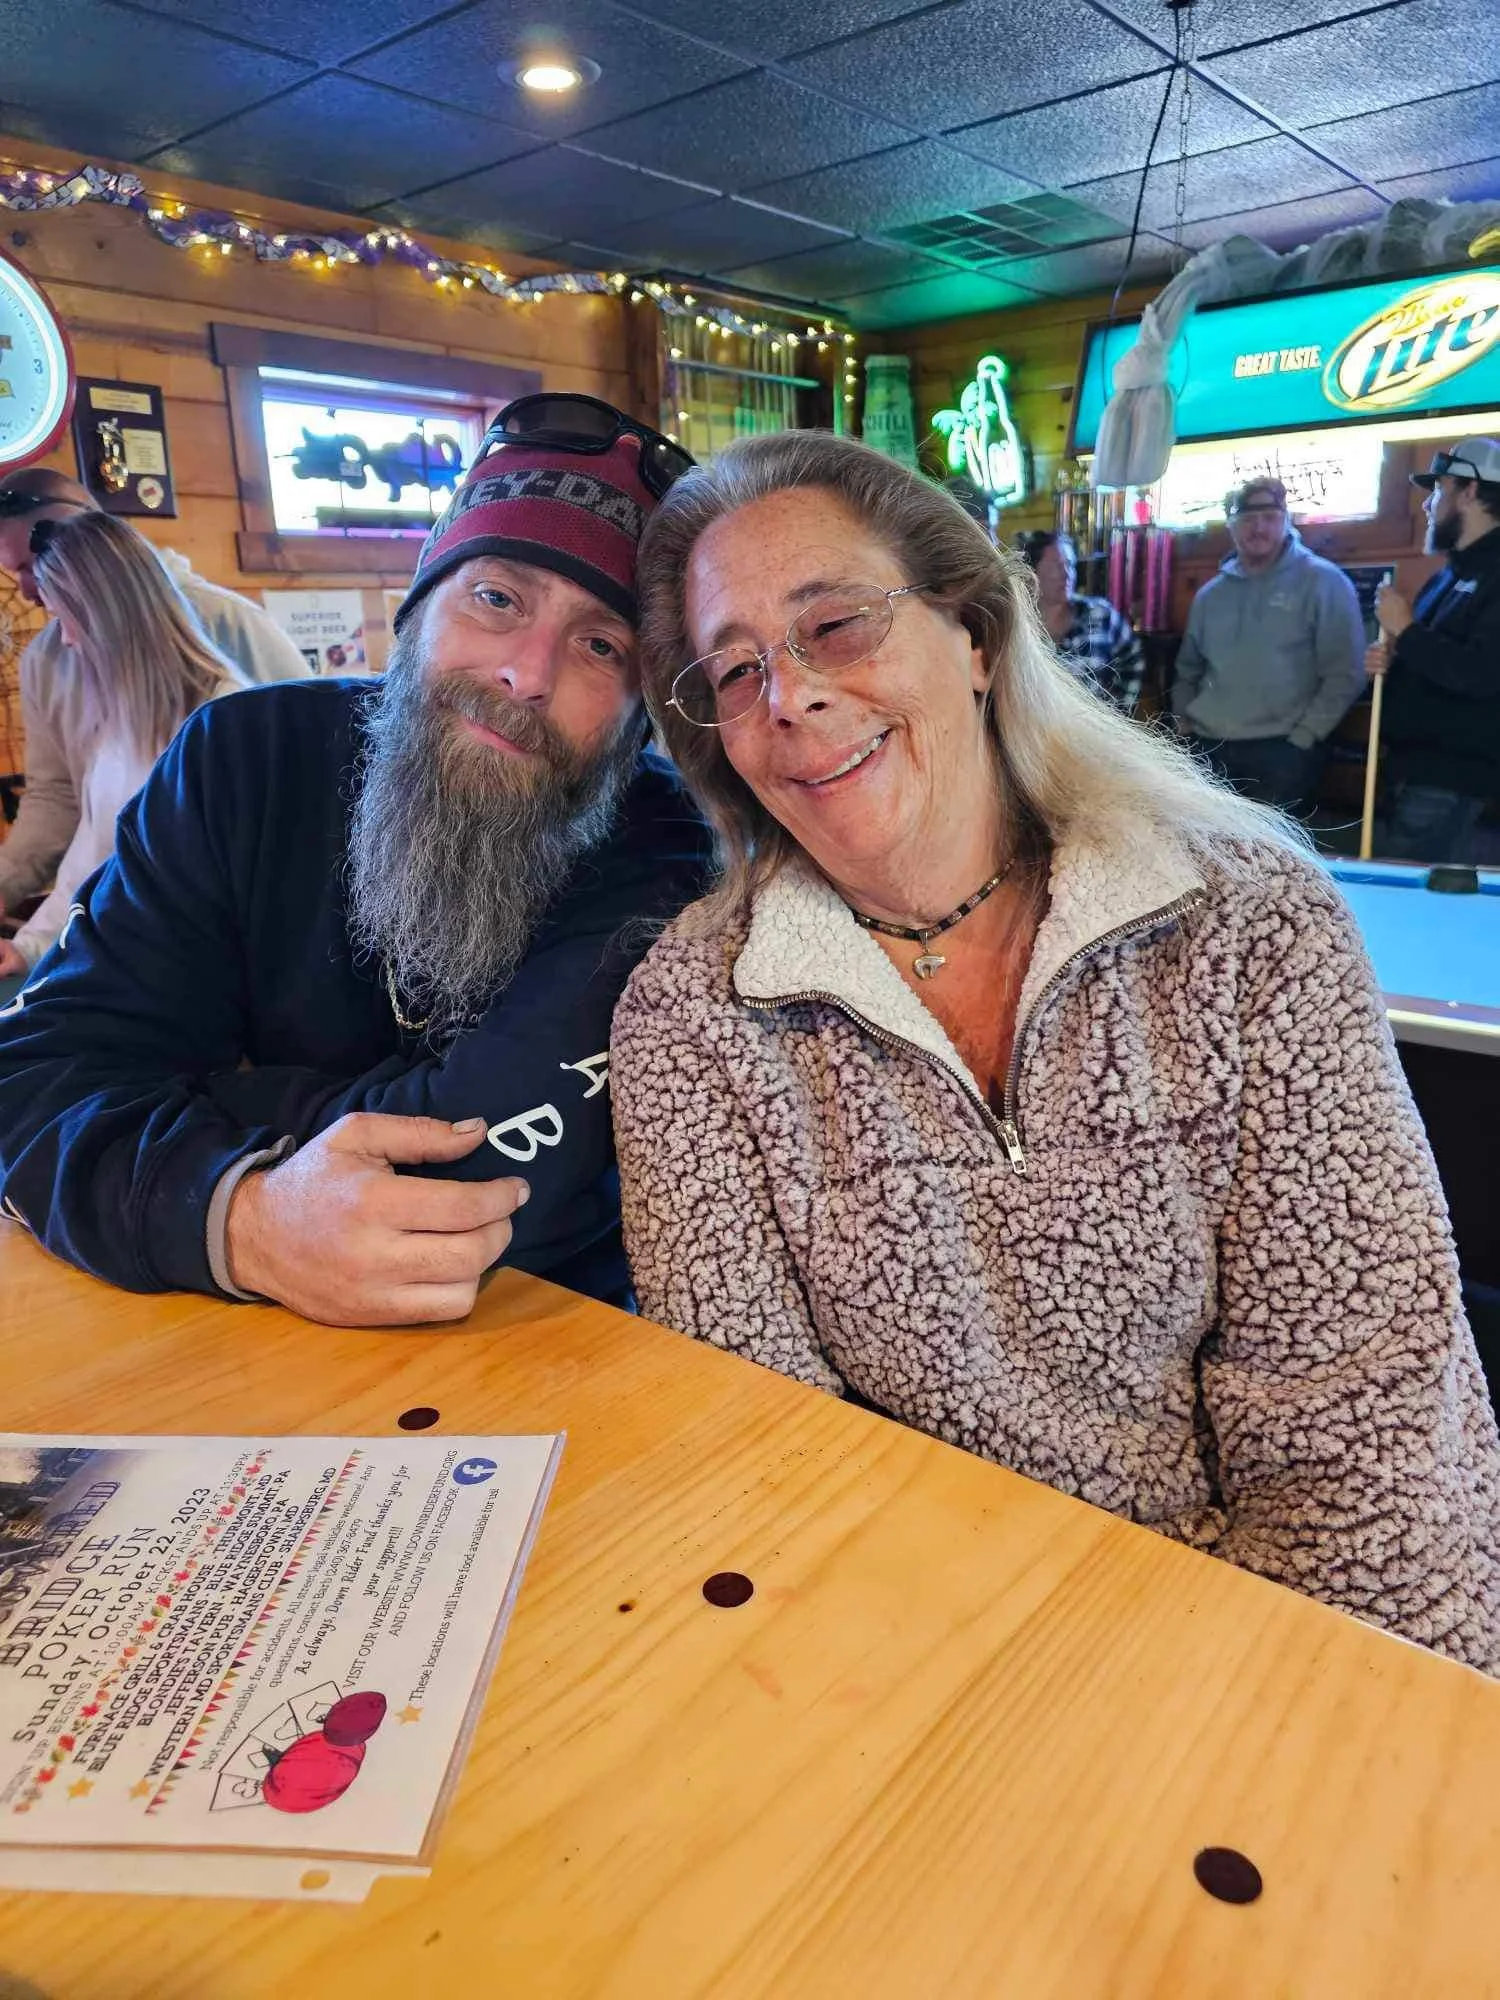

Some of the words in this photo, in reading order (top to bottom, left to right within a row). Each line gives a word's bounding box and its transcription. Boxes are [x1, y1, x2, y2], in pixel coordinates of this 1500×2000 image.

[32, 357, 43, 375] 3
[1234, 350, 1279, 378] GREAT
[254, 1474, 274, 1489] MD
[357, 1465, 378, 1480] Any
[388, 1465, 415, 1478] for
[385, 1480, 408, 1496] you
[485, 1488, 500, 1499] us!
[364, 1498, 395, 1527] thanks
[430, 1487, 461, 1534] FACEBOOK
[480, 1500, 496, 1512] for
[211, 1492, 265, 1553] THURMONT,
[319, 1519, 347, 1550] vehicles
[465, 1513, 491, 1550] available
[142, 1524, 205, 1593] KICKSTANDS
[195, 1508, 215, 1520] UP
[352, 1531, 378, 1553] Fund
[368, 1526, 410, 1570] support!!!
[423, 1537, 440, 1550] ON
[307, 1553, 331, 1571] legal
[337, 1556, 366, 1582] Rider
[417, 1551, 434, 1563] US
[456, 1551, 477, 1572] food
[178, 1564, 216, 1601] HOUSE
[293, 1574, 317, 1598] street
[360, 1573, 388, 1596] your
[398, 1565, 428, 1608] FOLLOW
[446, 1573, 468, 1598] have
[0, 1534, 121, 1668] BRIDGE
[16, 1586, 116, 1678] POKER
[96, 1527, 158, 1576] RUN
[135, 1657, 192, 1726] BLONDIE'S
[180, 1601, 226, 1654] TAVERN
[219, 1514, 281, 1592] WAYNESBORO,
[270, 1497, 290, 1512] PA
[161, 1642, 219, 1715] JEFFERSON
[208, 1614, 236, 1638] PUB
[228, 1525, 291, 1604] HAGERSTOWN,
[279, 1505, 301, 1522] MD
[285, 1601, 303, 1613] All
[295, 1601, 321, 1633] contact
[311, 1577, 334, 1598] Barb
[323, 1586, 351, 1612] Down
[439, 1600, 458, 1619] will
[9, 1649, 100, 1741] Sunday,
[82, 1561, 160, 1639] October
[145, 1530, 182, 1554] 22,
[168, 1488, 212, 1523] 2023
[85, 1733, 125, 1772] BLUE
[113, 1687, 154, 1729] RIDGE
[142, 1599, 211, 1683] SPORTSMANS
[203, 1562, 233, 1590] BLUE
[223, 1529, 254, 1560] RIDGE
[243, 1485, 283, 1527] SUMMIT,
[272, 1470, 291, 1482] PA
[143, 1705, 200, 1776] WESTERN
[188, 1677, 216, 1701] MD
[204, 1592, 266, 1674] SPORTSMANS
[254, 1560, 284, 1590] CLUB
[276, 1485, 329, 1552] SHARPSBURG,
[317, 1467, 338, 1483] MD
[154, 1604, 190, 1638] CRAB
[386, 1611, 408, 1636] AND
[147, 1642, 164, 1650] &
[342, 1658, 368, 1687] VISIT
[356, 1632, 379, 1656] OUR
[368, 1582, 401, 1628] WEBSITE
[420, 1621, 451, 1667] locations
[119, 1653, 158, 1690] GRILL
[247, 1666, 267, 1680] for
[291, 1660, 313, 1674] As
[407, 1670, 433, 1701] These
[211, 1683, 261, 1745] responsible
[69, 1693, 131, 1764] FURNACE
[199, 1747, 224, 1770] Not
